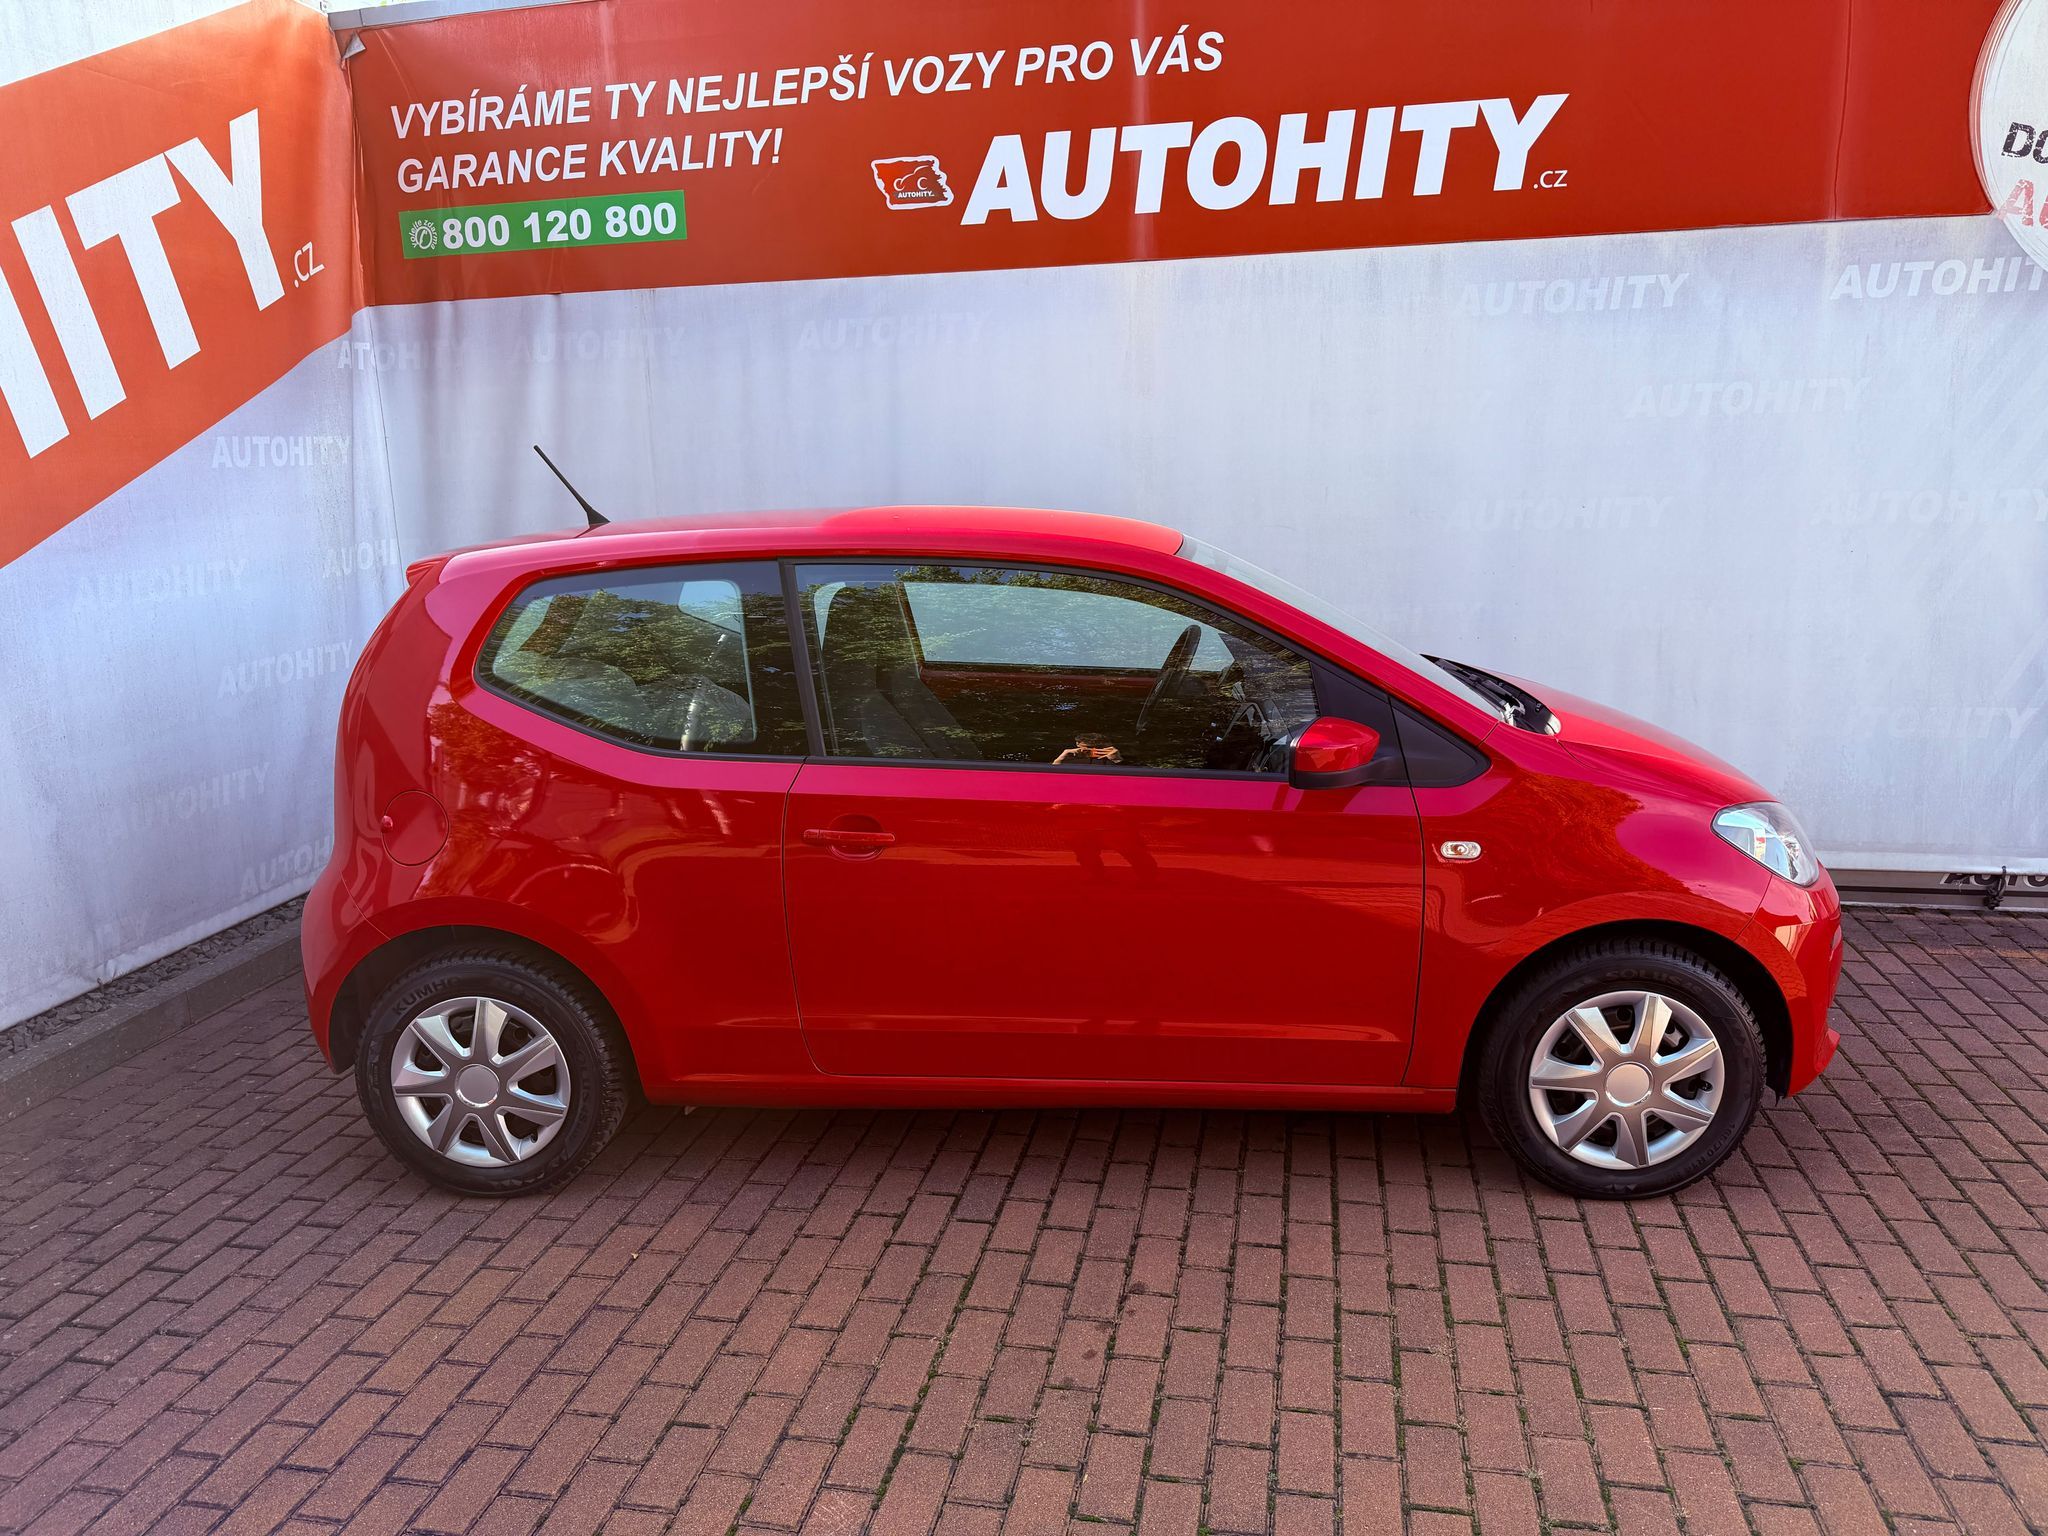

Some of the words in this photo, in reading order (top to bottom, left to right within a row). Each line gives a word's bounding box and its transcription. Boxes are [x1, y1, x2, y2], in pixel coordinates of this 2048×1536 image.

[390, 83, 592, 139] VYBÍRÁME
[604, 80, 657, 120] TY
[666, 52, 874, 115] NEJLEPŠÍ
[883, 50, 1006, 97] VOZY
[1014, 40, 1114, 86] PRO
[1130, 24, 1225, 77] VÁS
[397, 143, 588, 193] GARANCE
[599, 127, 783, 177] KVALITY!
[960, 93, 1570, 226] AUTOHITY
[442, 214, 510, 250] 800
[523, 208, 592, 243] 120
[605, 202, 677, 238] 800
[211, 435, 350, 469] AUTOHITY
